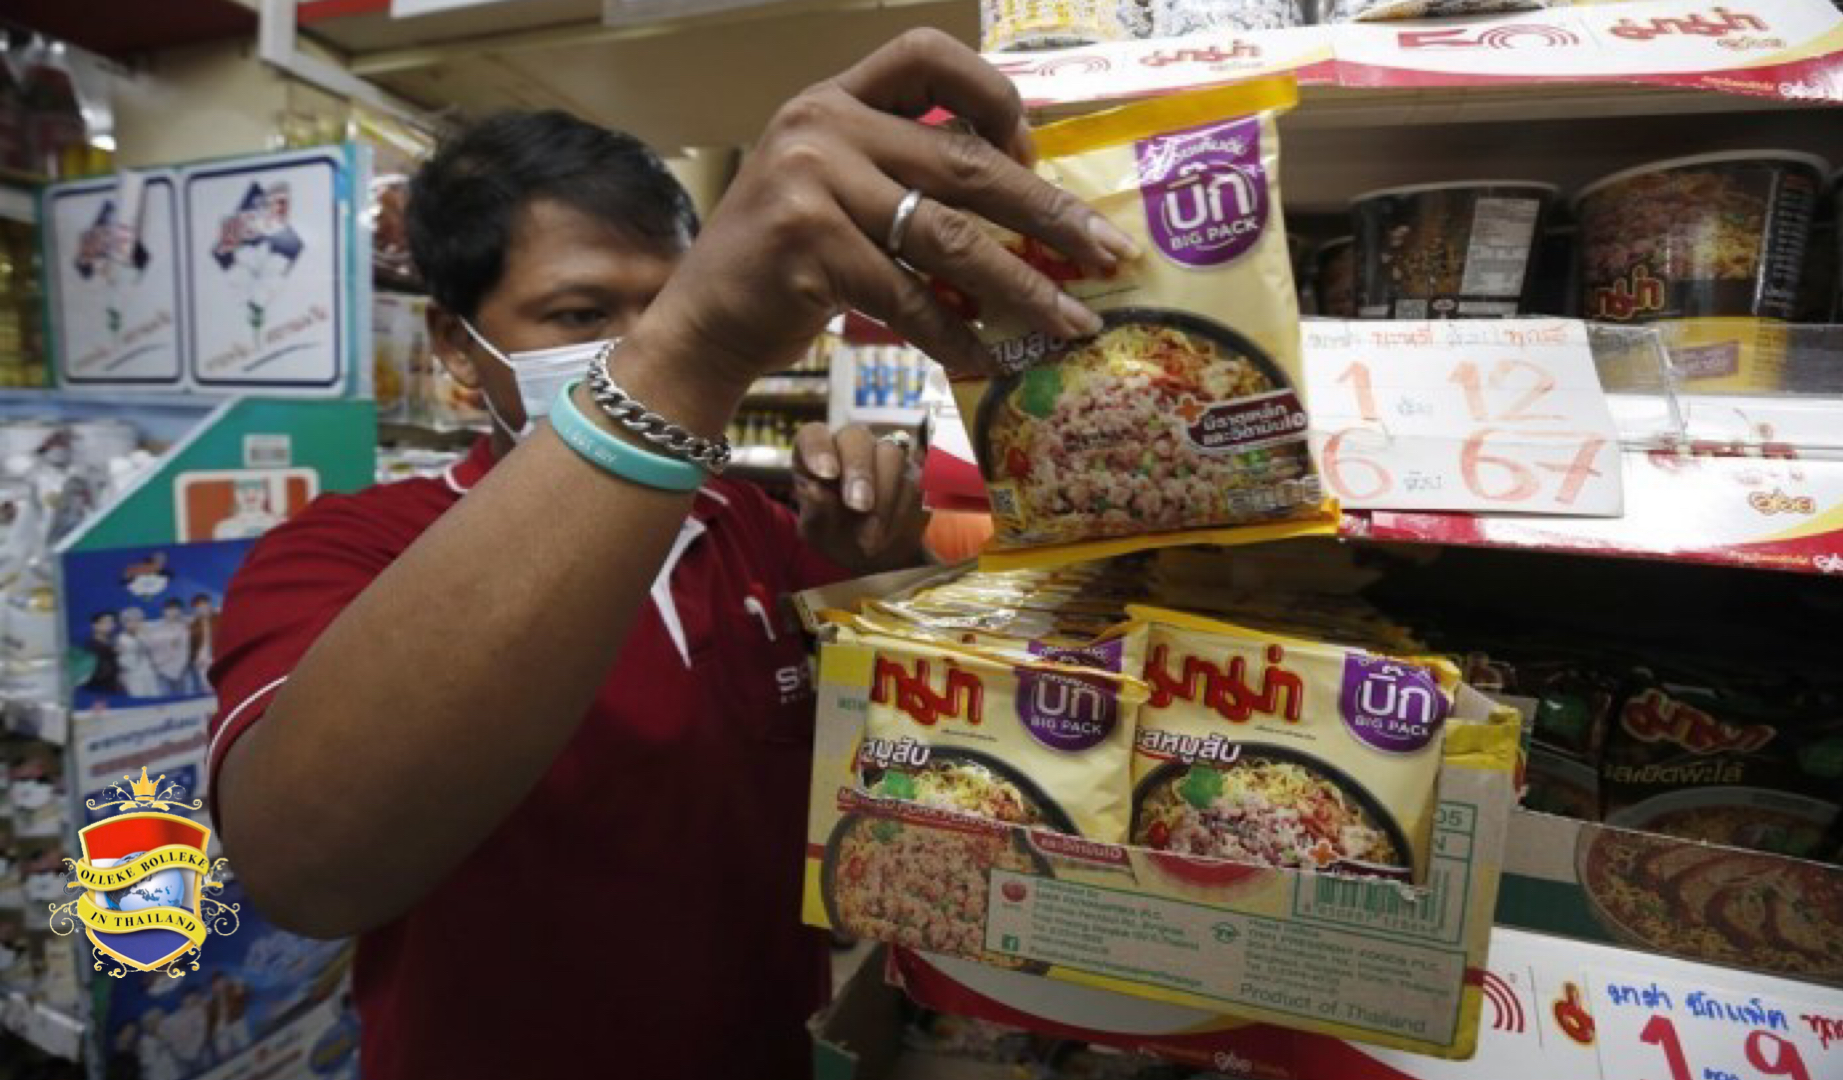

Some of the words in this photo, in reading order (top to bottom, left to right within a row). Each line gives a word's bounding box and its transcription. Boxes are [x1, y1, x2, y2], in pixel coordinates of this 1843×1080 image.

[1170, 231, 1203, 251] BIG
[1207, 217, 1259, 241] PACK
[1335, 361, 1380, 420] 1
[1448, 359, 1569, 421] 12
[1323, 428, 1393, 499] 6
[1461, 428, 1608, 504] 67
[1030, 716, 1057, 730] BIG
[1062, 719, 1102, 735] PACK
[1354, 716, 1383, 731] BIG
[1388, 721, 1430, 736] PACK
[1240, 982, 1311, 1009] Product
[1318, 1001, 1339, 1016] of
[1346, 1005, 1427, 1033] Thailand
[1639, 1014, 1694, 1080] 1
[1744, 1029, 1812, 1080] 9
